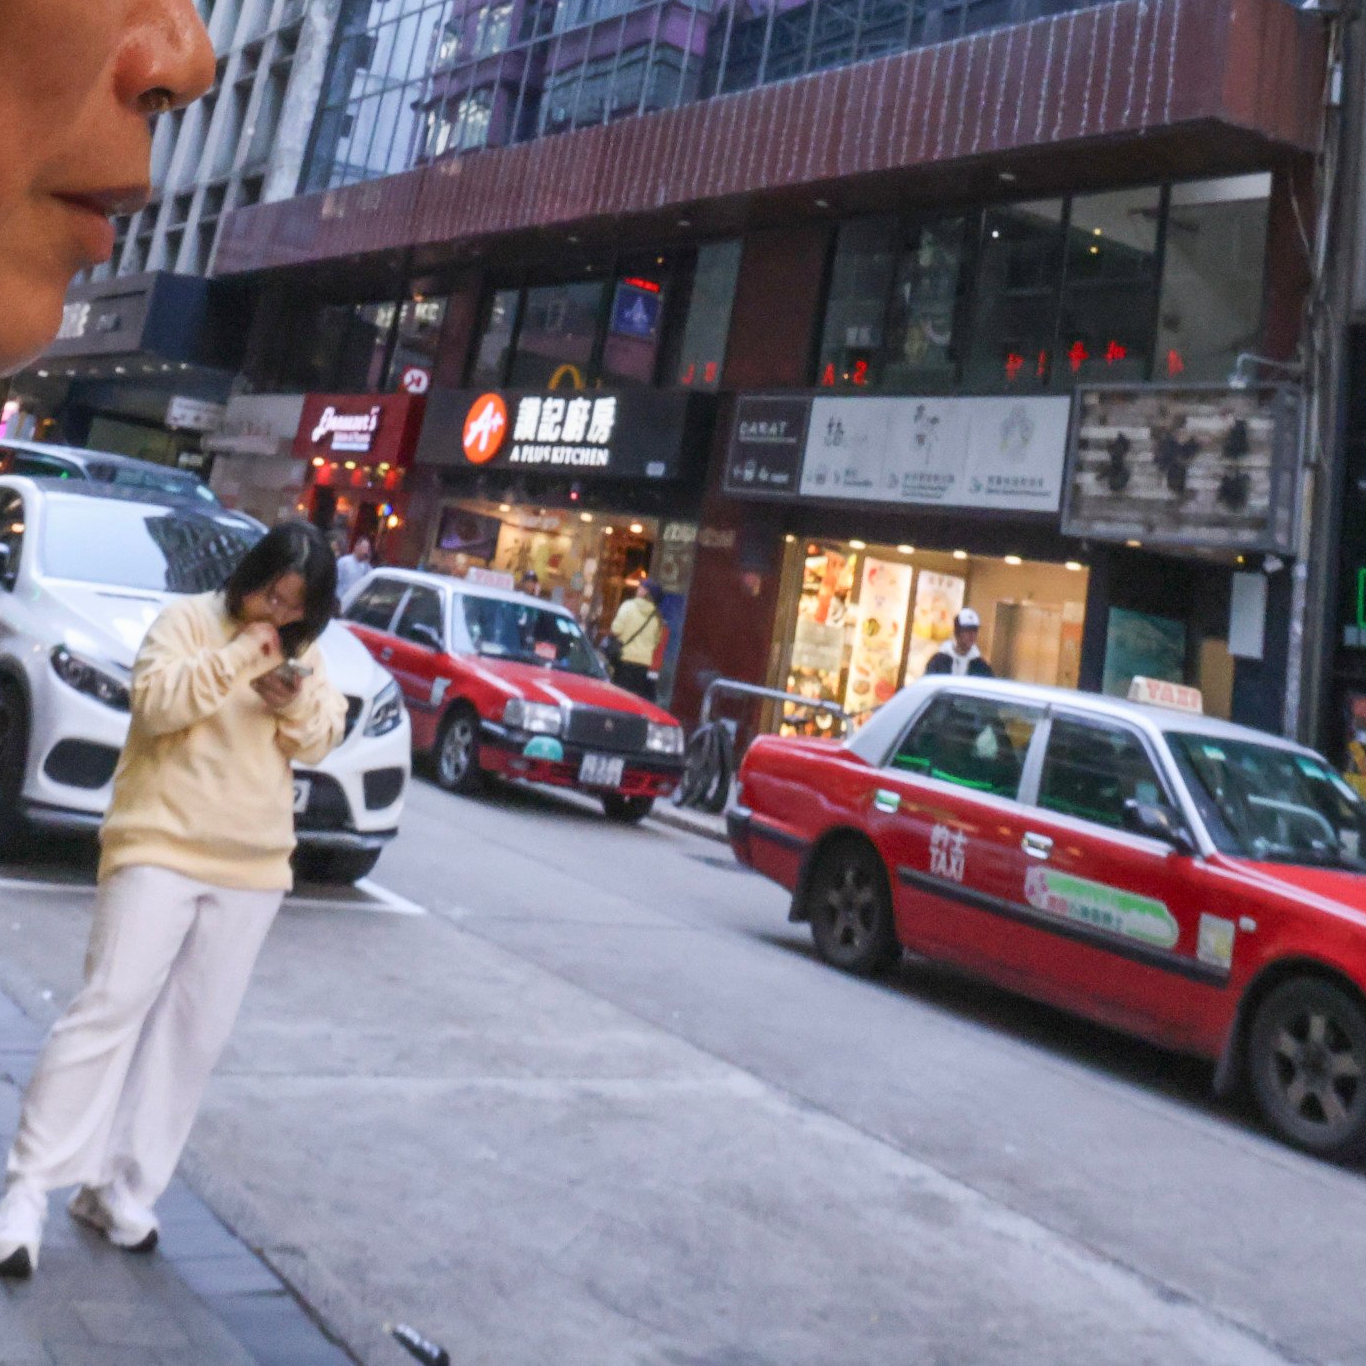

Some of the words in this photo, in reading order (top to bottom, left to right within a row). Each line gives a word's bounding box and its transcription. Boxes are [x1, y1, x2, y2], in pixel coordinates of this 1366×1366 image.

[550, 445, 610, 467] KITCHEN
[1146, 677, 1201, 709] TAXI
[930, 849, 966, 883] TAXI
